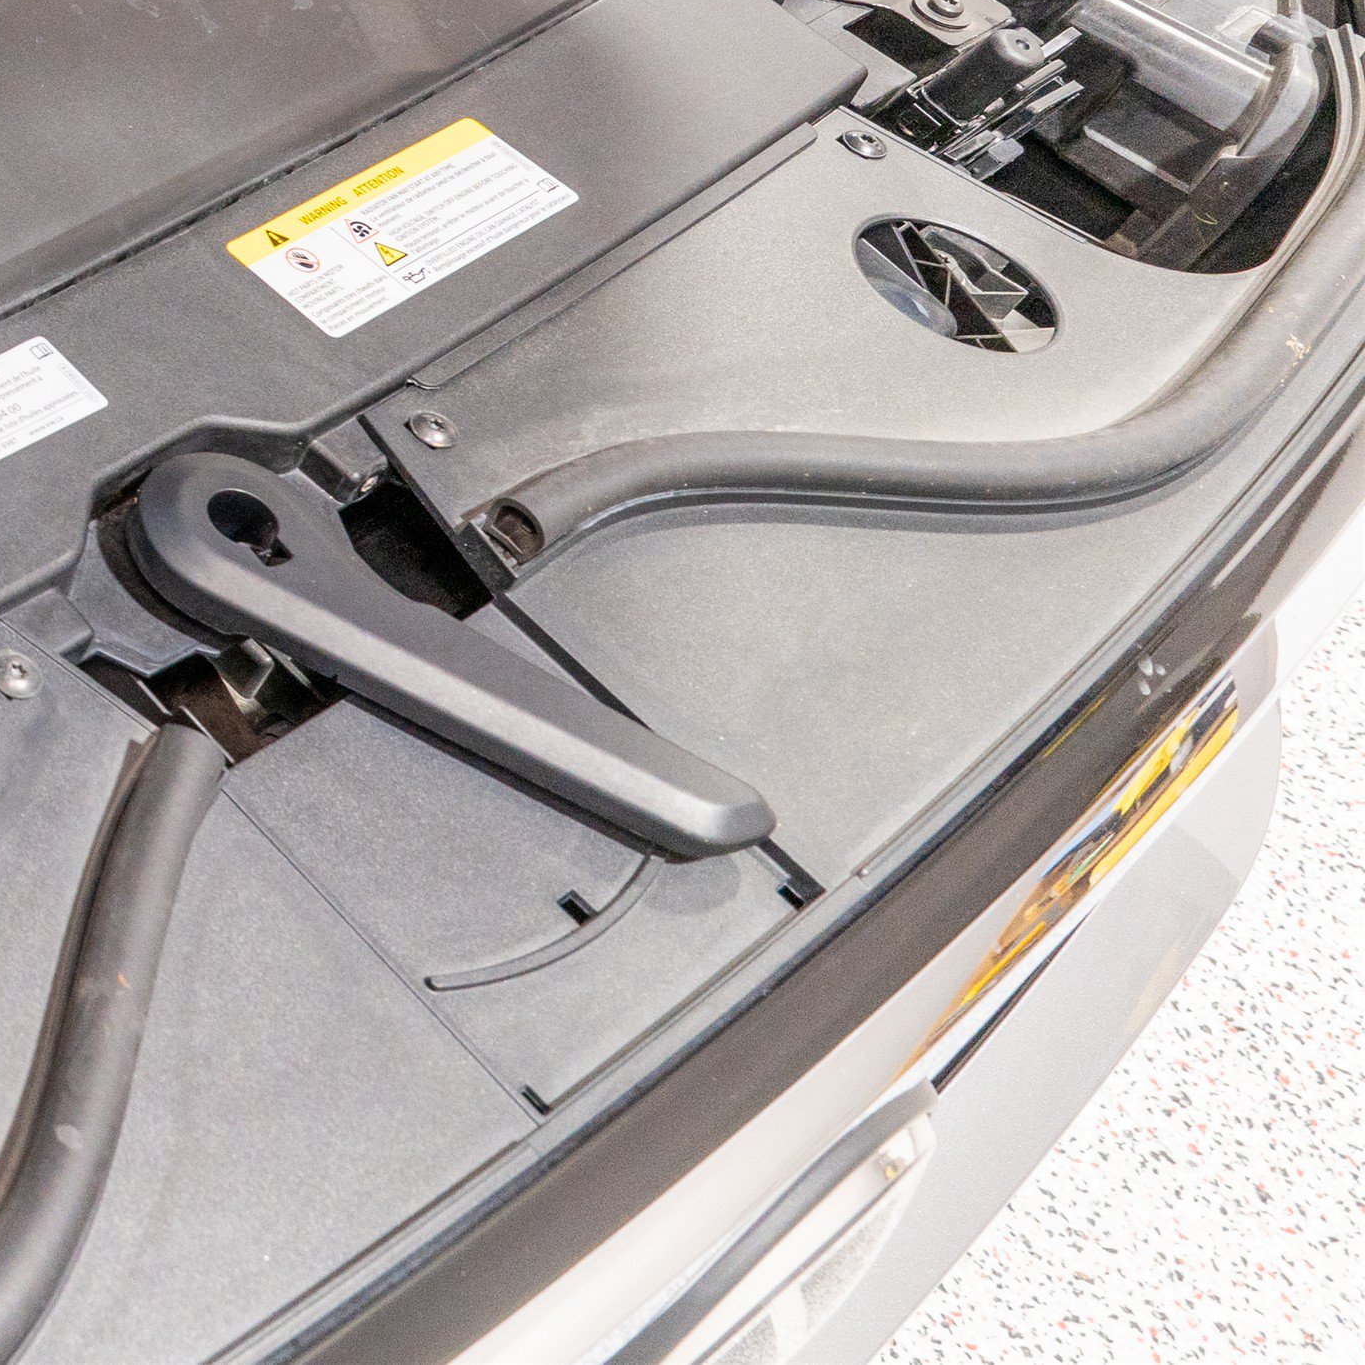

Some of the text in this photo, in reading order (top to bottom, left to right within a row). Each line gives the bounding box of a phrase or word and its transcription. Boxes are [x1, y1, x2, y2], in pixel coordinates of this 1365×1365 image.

[298, 165, 405, 226] WARNING ATTENTION
[5, 402, 23, 414] 00
